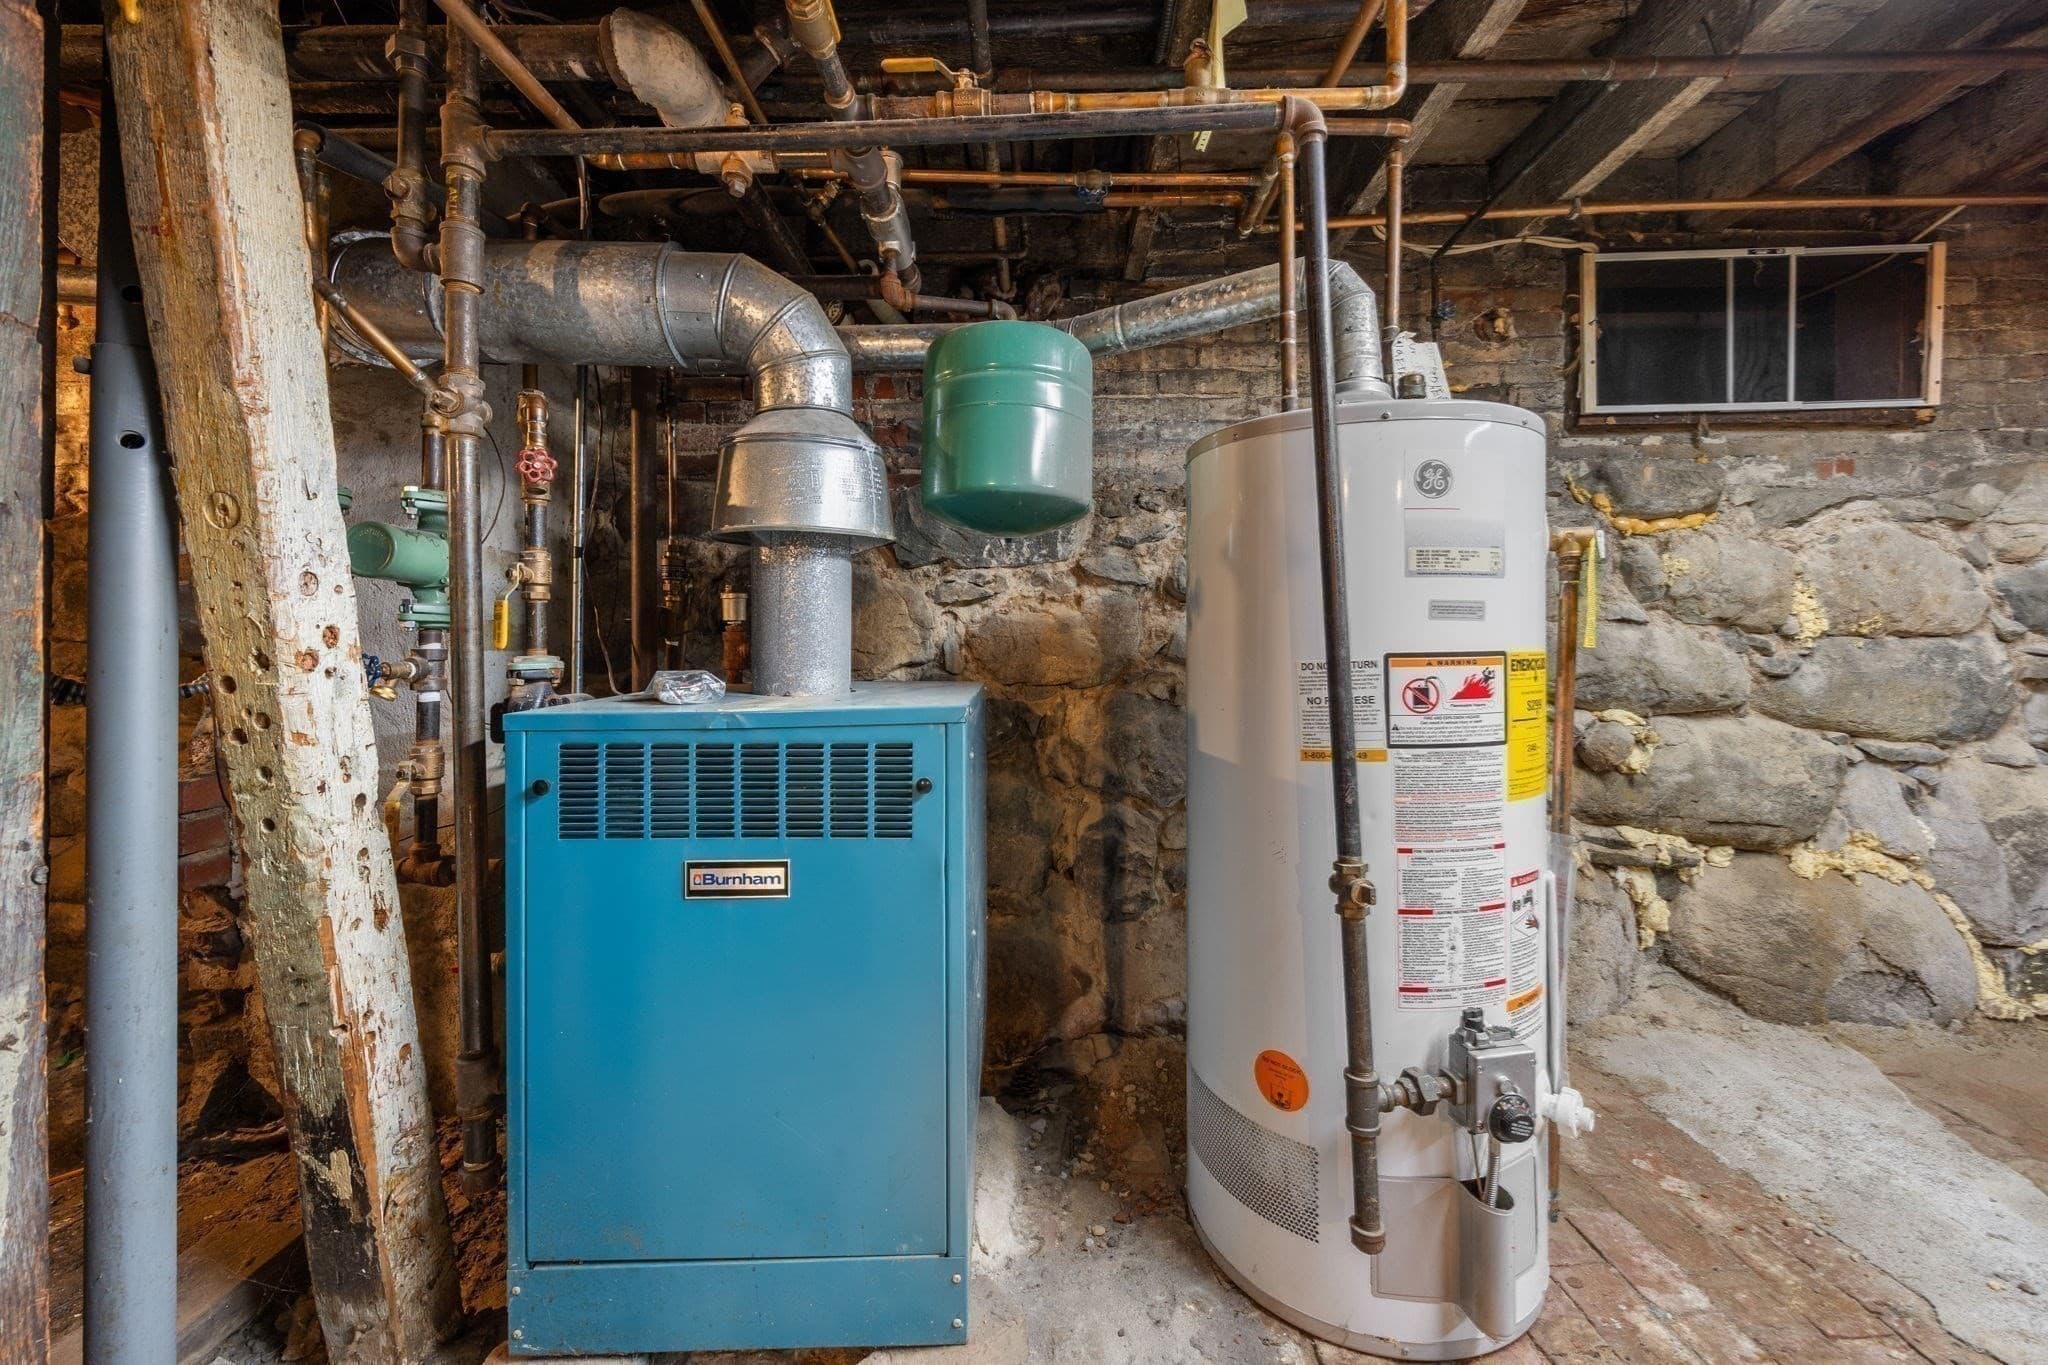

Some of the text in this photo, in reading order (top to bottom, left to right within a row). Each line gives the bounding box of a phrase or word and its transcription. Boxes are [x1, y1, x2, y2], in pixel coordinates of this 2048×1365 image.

[1301, 662, 1314, 671] DO
[1351, 660, 1377, 669] TURN
[1307, 697, 1321, 705] NO
[702, 873, 781, 885] Burnham
